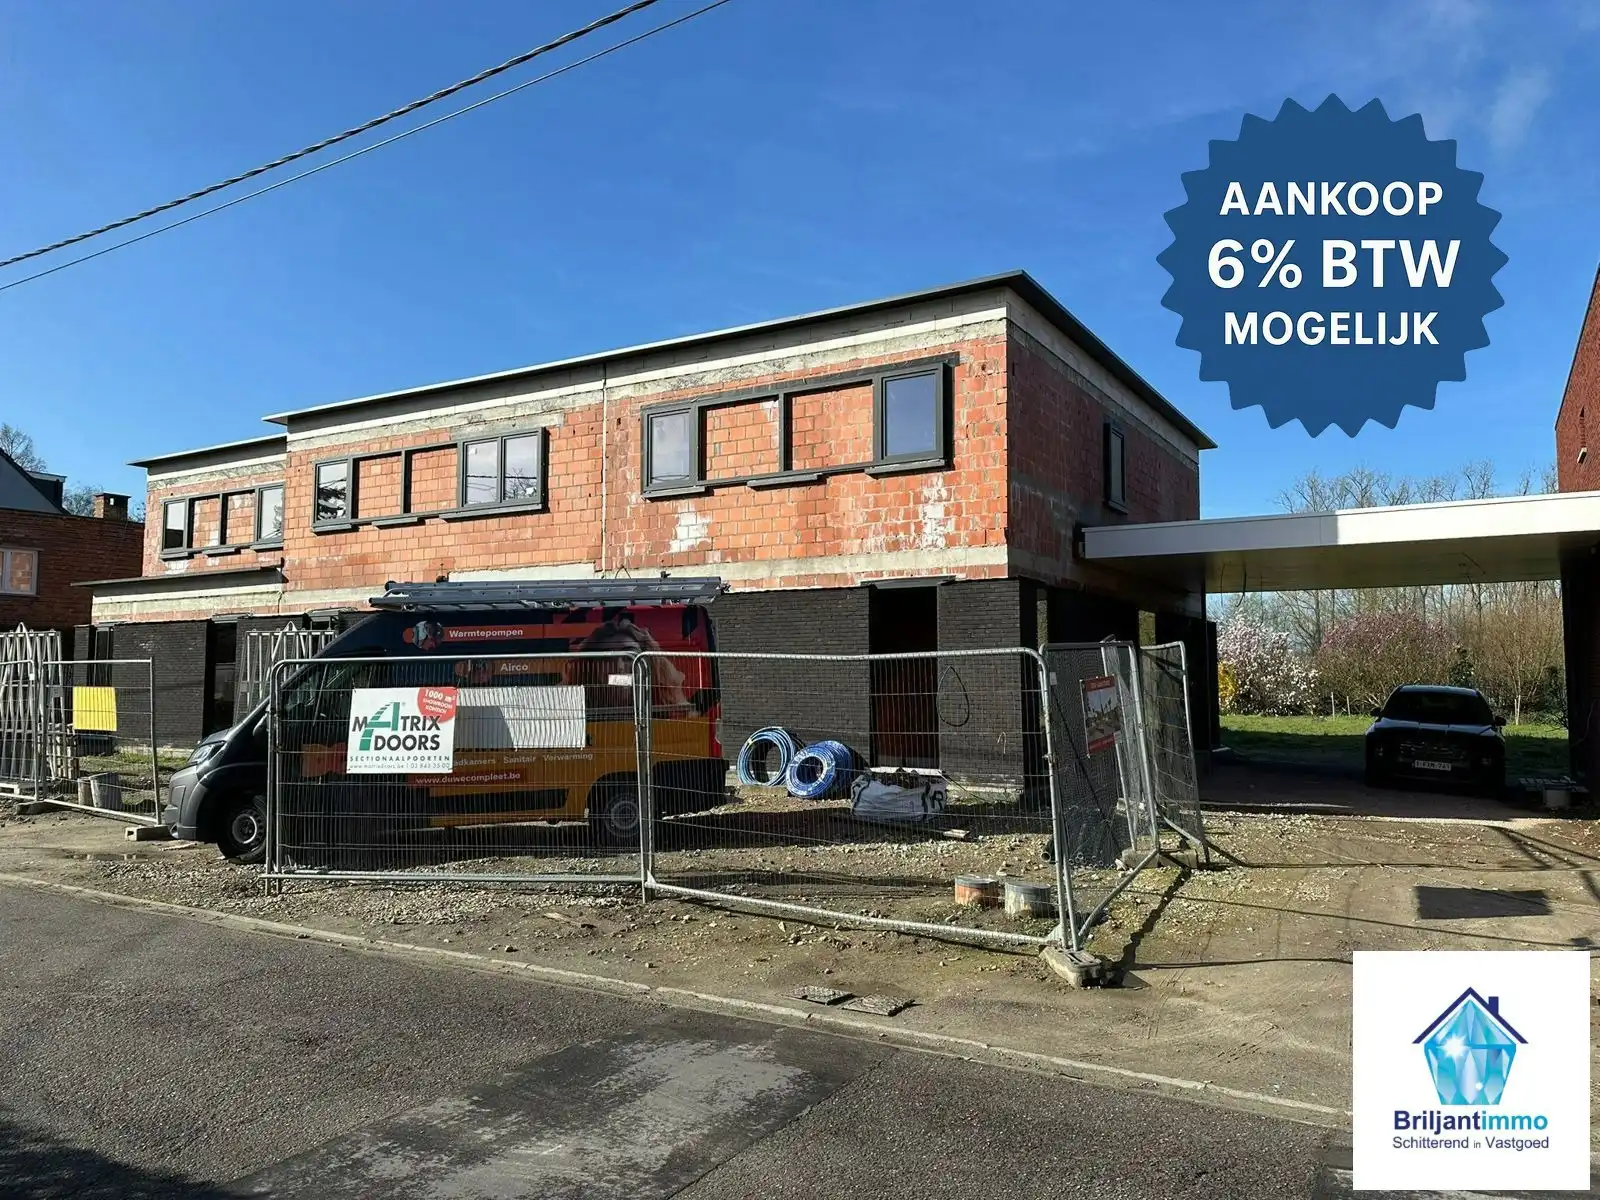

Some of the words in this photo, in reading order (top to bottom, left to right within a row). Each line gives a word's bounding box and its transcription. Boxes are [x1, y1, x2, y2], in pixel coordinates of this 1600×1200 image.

[448, 628, 524, 639] Warmtepompen
[500, 662, 529, 672] Airco
[425, 689, 443, 700] 1000
[352, 702, 441, 733] MATRIX
[373, 734, 441, 751] DOORS
[453, 757, 497, 767] adkamers
[503, 755, 536, 764] Sanitair
[543, 752, 593, 763] Verwarming
